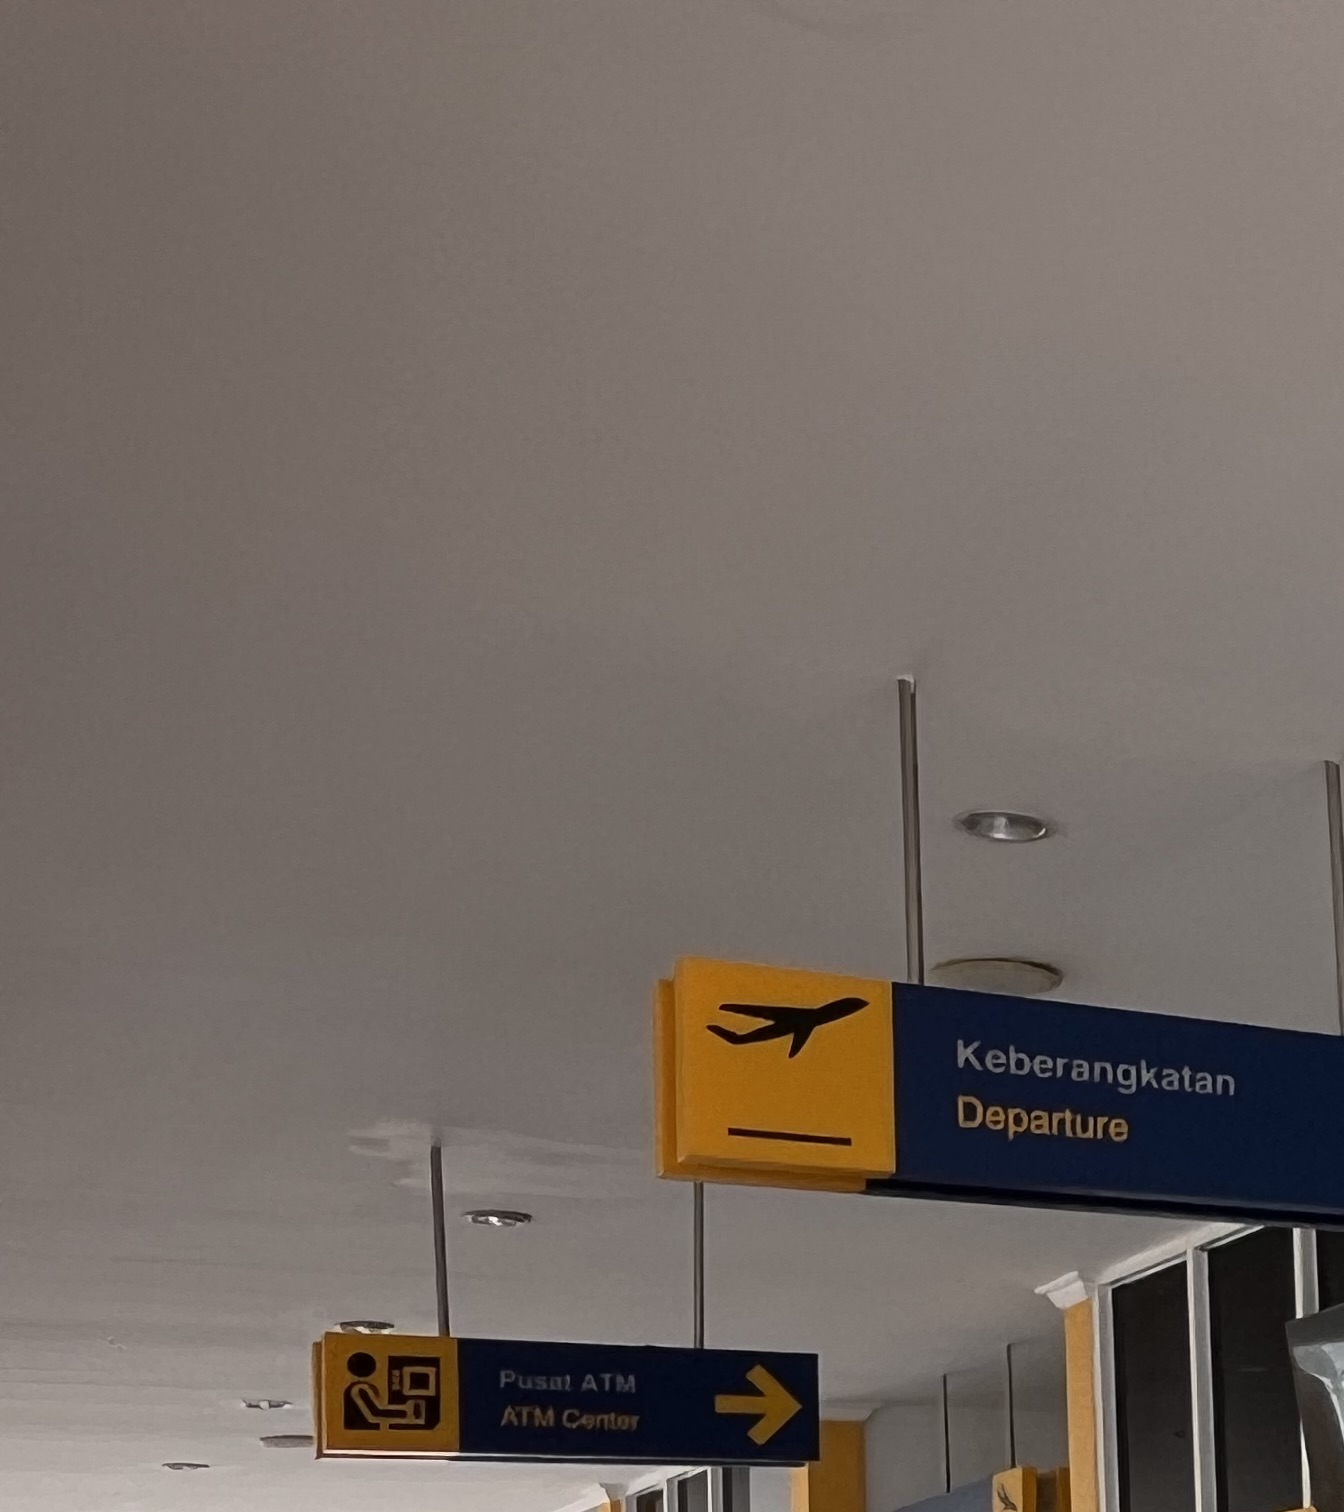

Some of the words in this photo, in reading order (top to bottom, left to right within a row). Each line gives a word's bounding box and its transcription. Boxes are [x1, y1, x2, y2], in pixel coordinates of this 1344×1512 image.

[956, 1039, 1236, 1096] Keberangkatan
[956, 1095, 1129, 1142] Departure
[580, 1373, 636, 1393] ATM
[500, 1404, 555, 1428] ATM
[562, 1408, 640, 1431] Center
